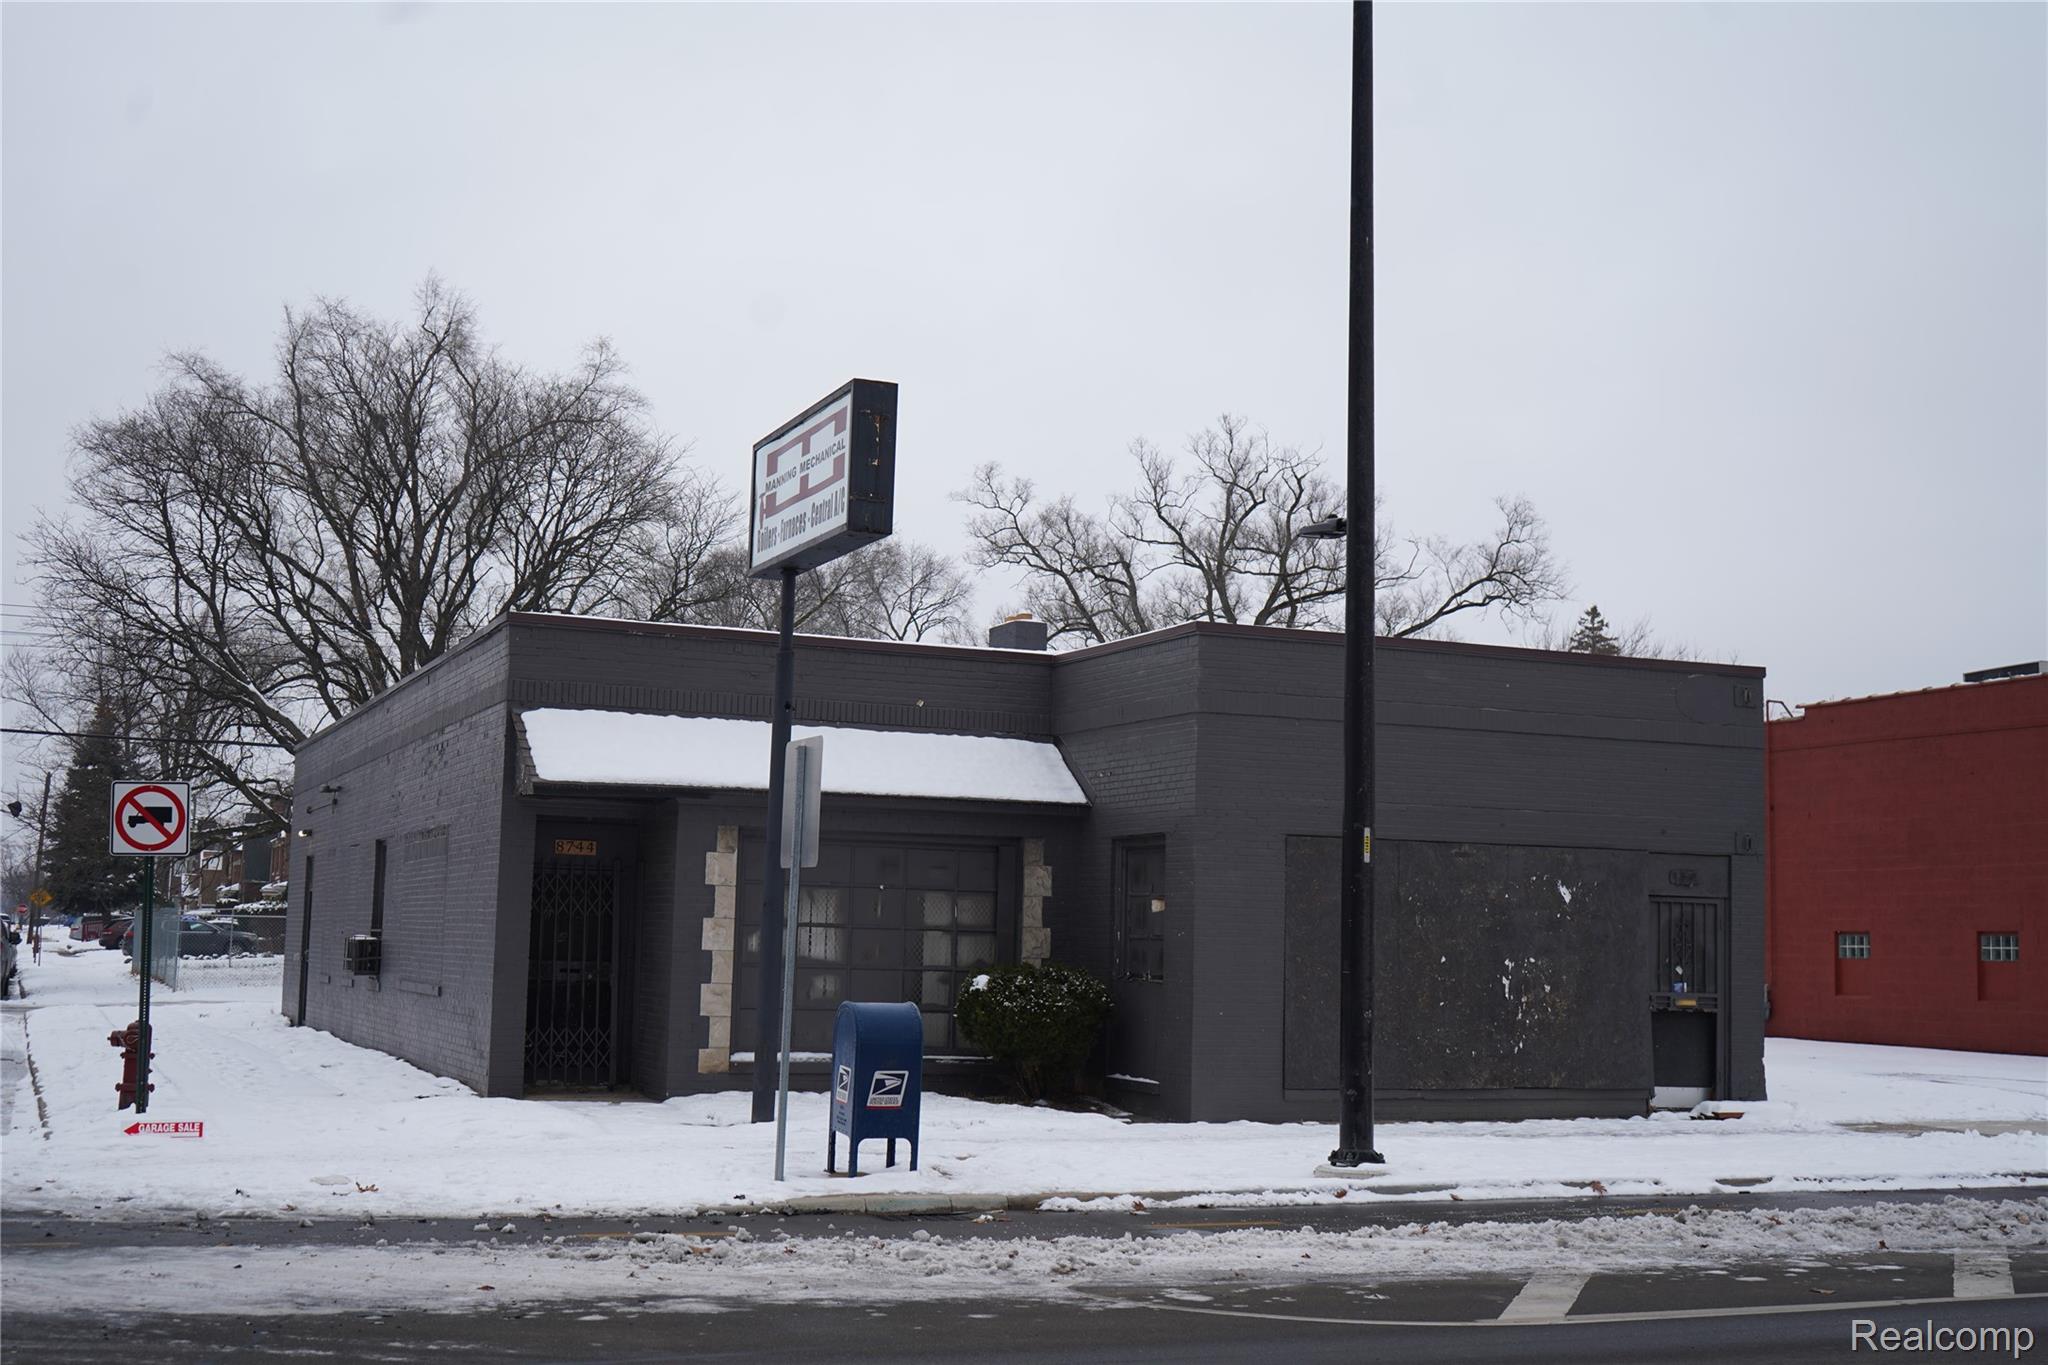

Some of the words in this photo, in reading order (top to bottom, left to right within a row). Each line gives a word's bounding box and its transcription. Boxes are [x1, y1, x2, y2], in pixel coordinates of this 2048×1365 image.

[765, 466, 797, 492] MANNING
[799, 438, 846, 474] MECHANICAL
[780, 512, 806, 543] Furnaces
[811, 493, 833, 528] Central
[833, 486, 845, 517] A/C
[556, 840, 594, 853] 8744
[138, 1123, 175, 1132] GARAGE
[177, 1122, 201, 1132] SALE
